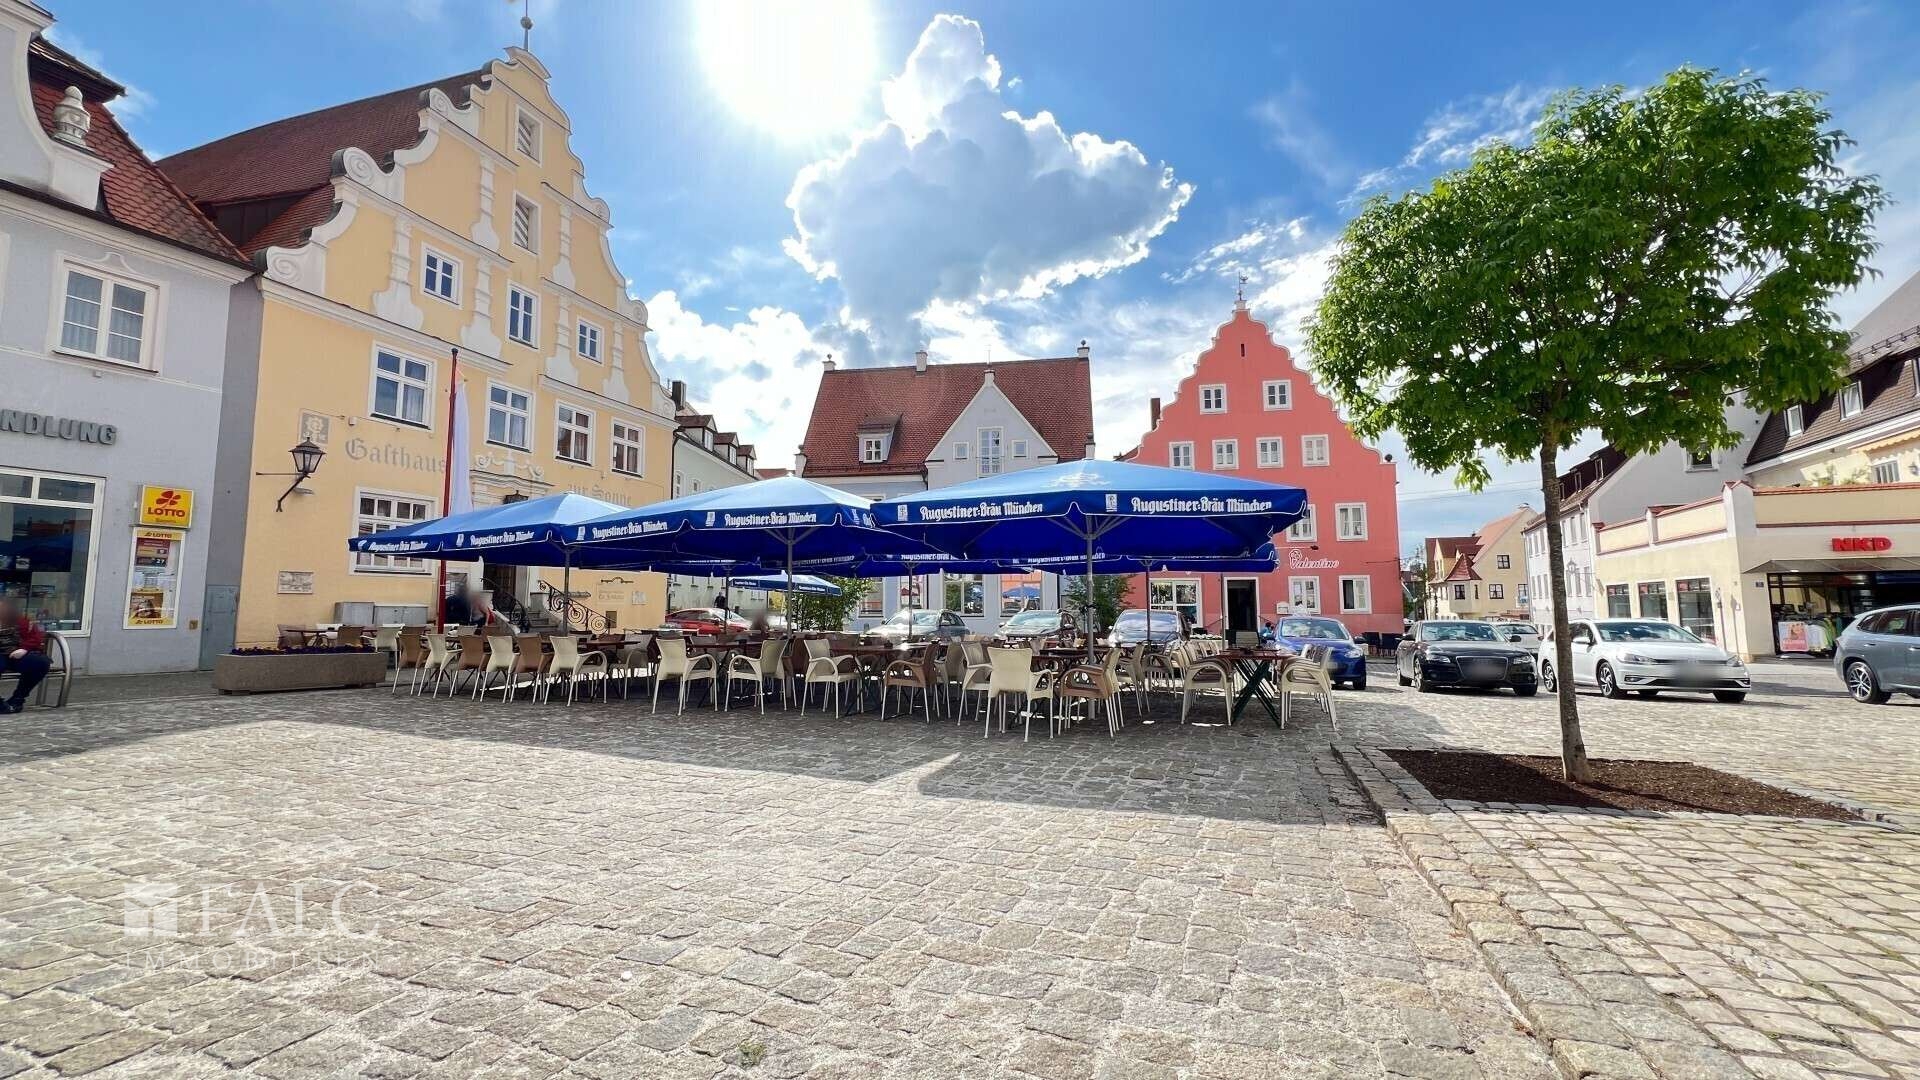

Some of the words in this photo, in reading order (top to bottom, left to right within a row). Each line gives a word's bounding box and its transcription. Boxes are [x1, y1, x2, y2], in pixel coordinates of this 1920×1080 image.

[147, 507, 185, 518] LOTTO
[1003, 501, 1043, 516] München
[1226, 498, 1272, 513] München
[788, 511, 817, 523] München
[1832, 537, 1893, 552] NKD
